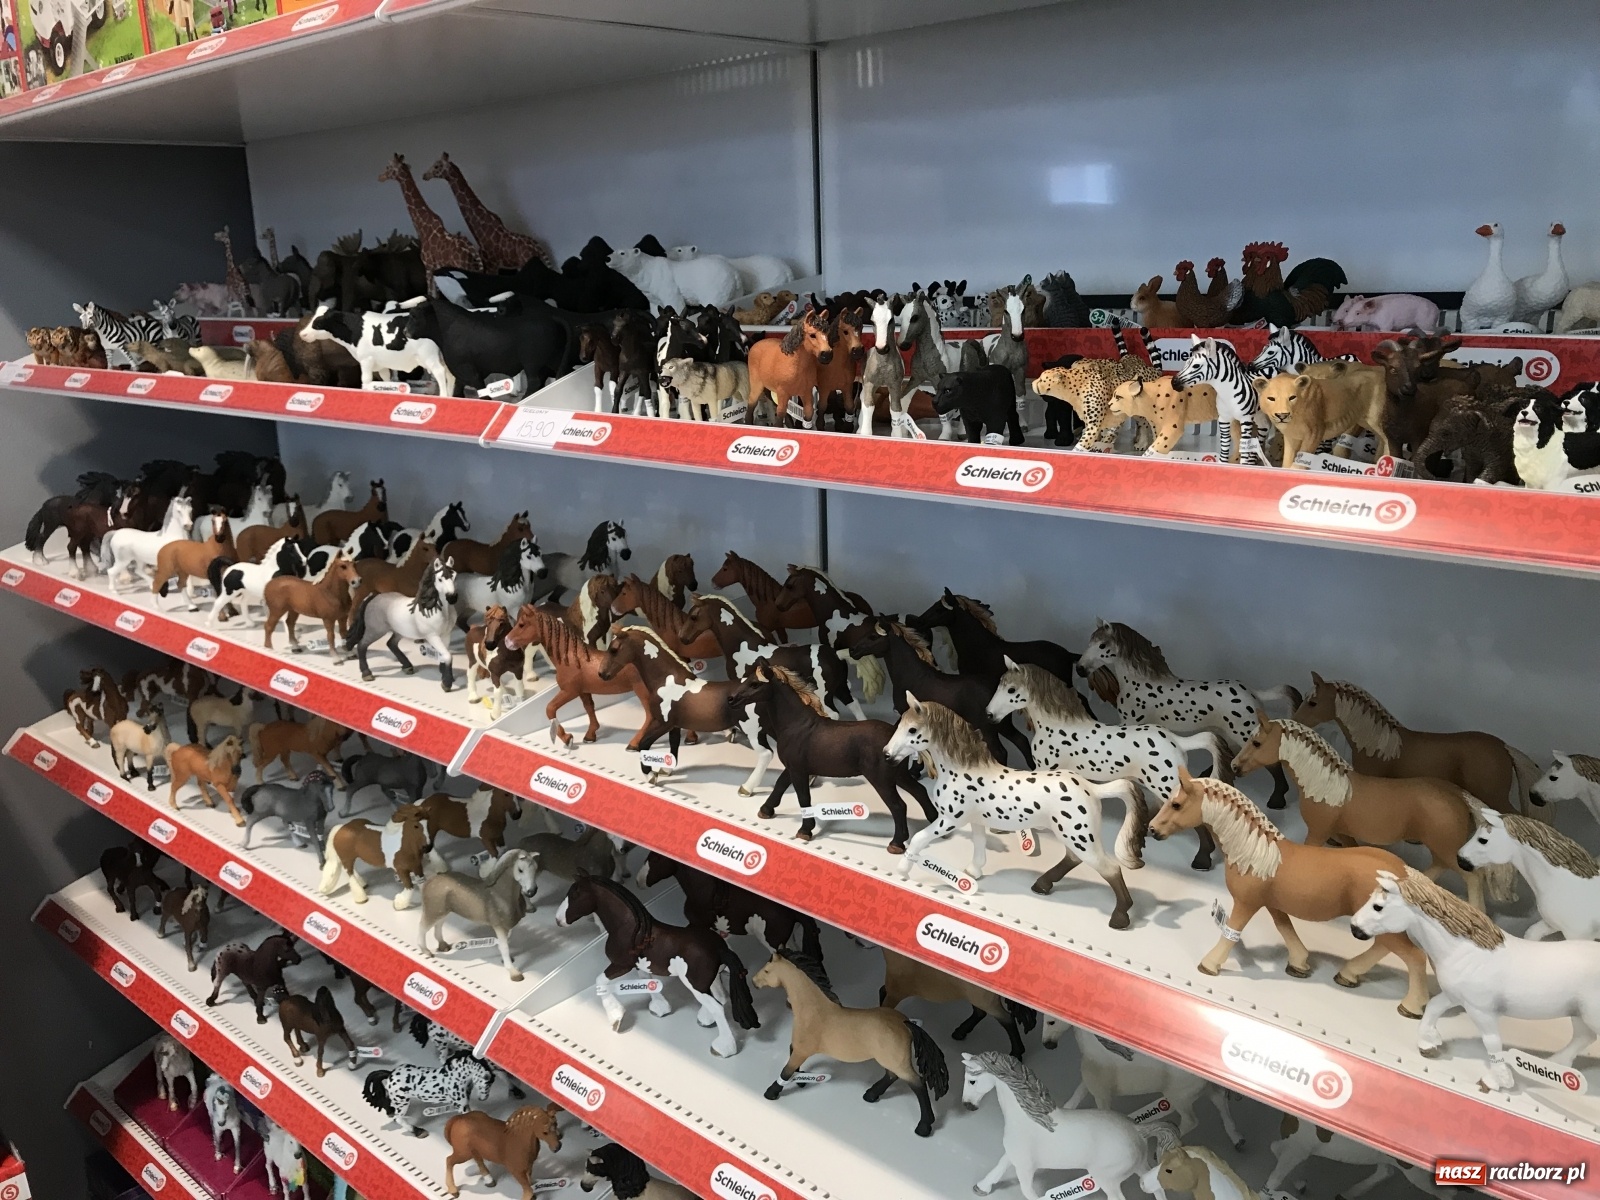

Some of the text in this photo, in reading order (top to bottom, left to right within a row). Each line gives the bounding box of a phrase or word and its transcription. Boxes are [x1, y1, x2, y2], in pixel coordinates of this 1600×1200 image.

[1092, 311, 1105, 324] 3+
[1158, 347, 1193, 362] Schlei
[394, 407, 421, 417] Schleich
[731, 443, 776, 457] Schleich
[961, 464, 1022, 482] Schleich
[1379, 460, 1393, 474] 3+
[1574, 481, 1600, 493] Schl
[1286, 495, 1372, 518] Schleich
[273, 674, 296, 689] Schleich
[376, 712, 401, 729] Schleich
[534, 772, 568, 793] Schleich
[822, 807, 852, 816] Schleich
[701, 836, 744, 862] Schleich
[222, 865, 241, 882] Schleich
[922, 859, 959, 881] Schleich
[307, 916, 328, 934] Schleich
[922, 923, 979, 956] Schleich
[407, 977, 433, 998] Schleich
[619, 983, 647, 991] Schleich
[1228, 1041, 1310, 1085] Schleich
[1515, 1056, 1562, 1084] Schleich
[243, 1072, 262, 1090] Schleich
[555, 1071, 588, 1098] Schleich
[325, 1138, 346, 1158] Schleich
[715, 1171, 756, 1200] Schleich
[1050, 1183, 1084, 1200] Schleich
